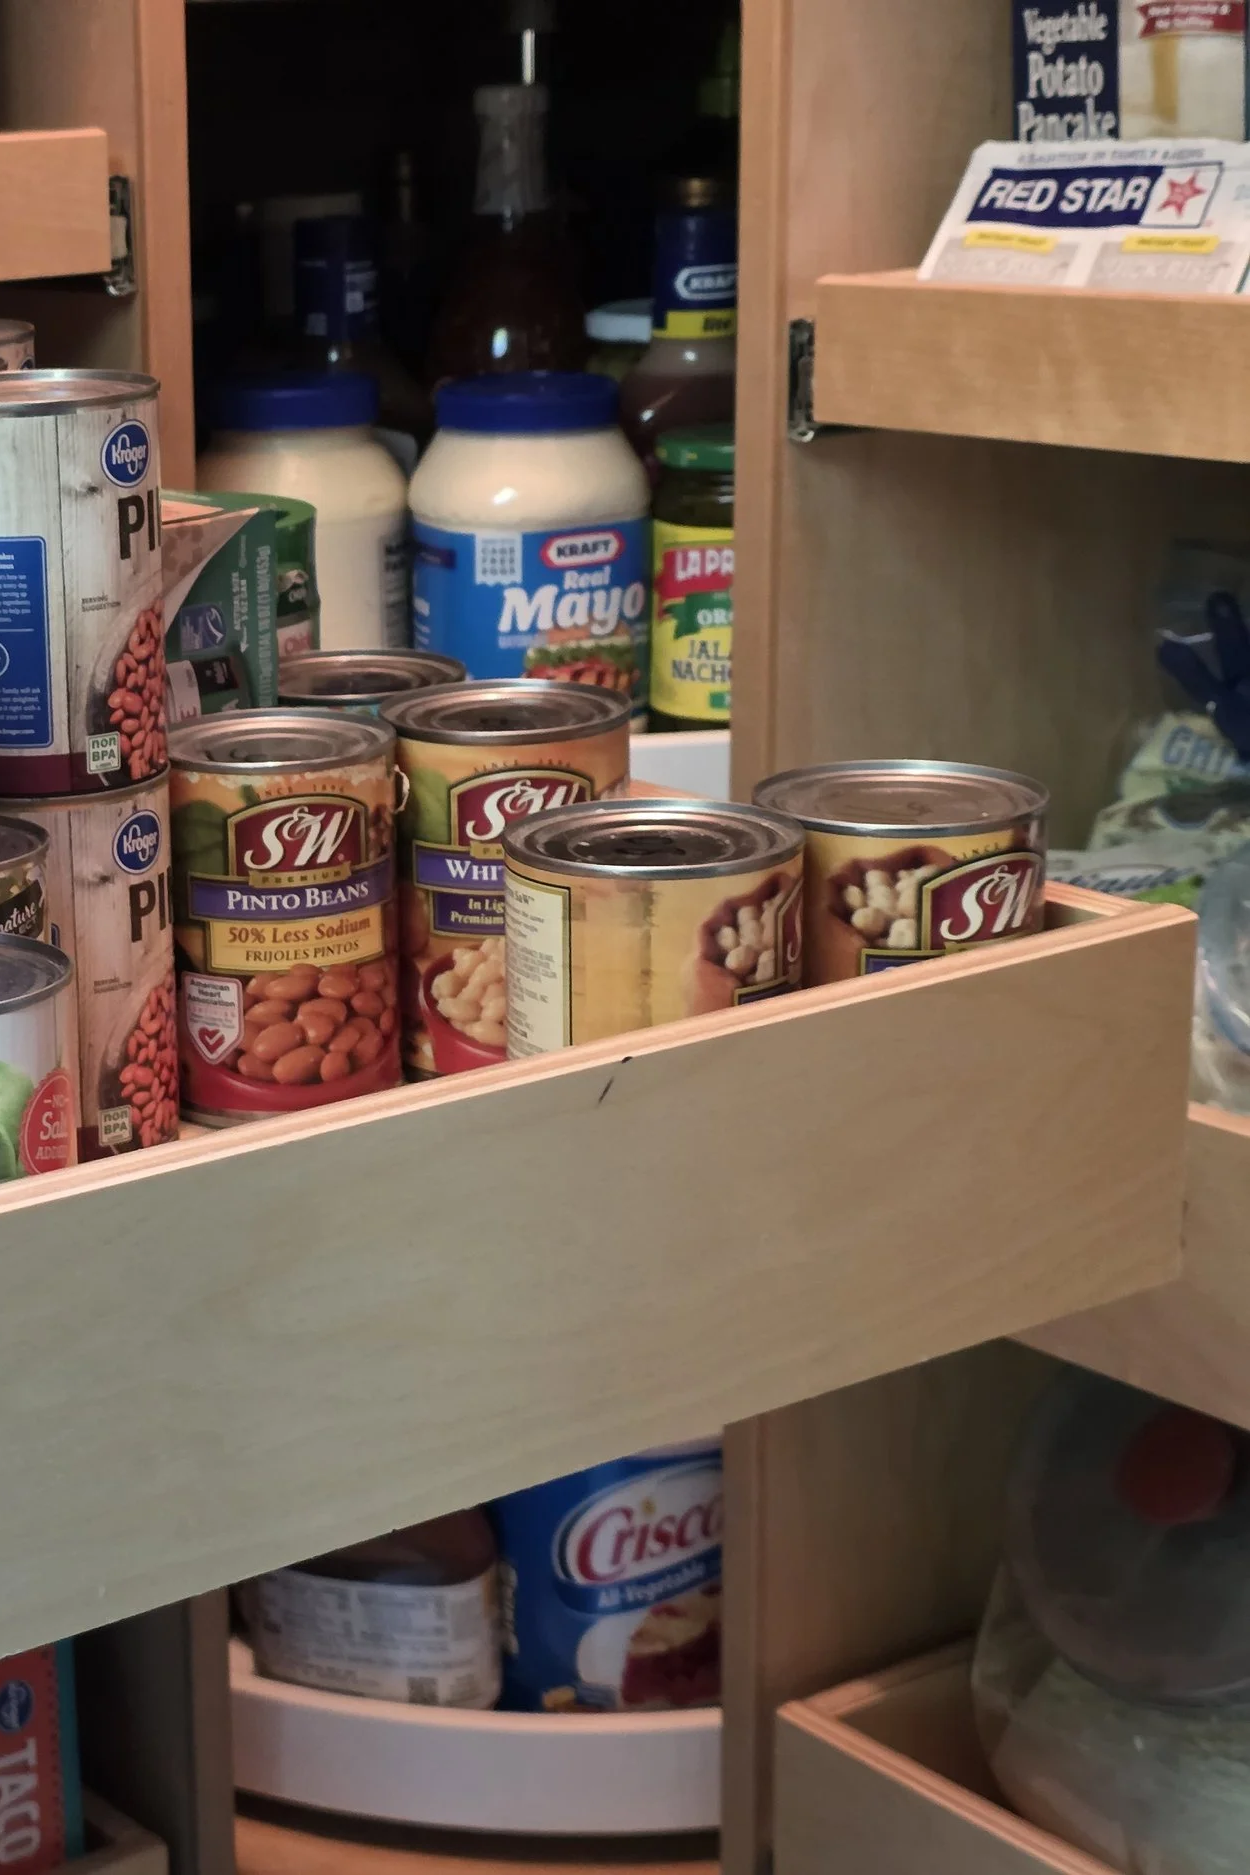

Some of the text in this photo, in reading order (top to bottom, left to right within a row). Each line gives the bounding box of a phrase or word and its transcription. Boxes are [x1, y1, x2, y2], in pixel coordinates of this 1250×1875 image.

[1022, 2, 1109, 56] Vegetable
[1026, 51, 1105, 99] Potato
[1017, 97, 1116, 143] Pancake
[978, 175, 1151, 214] RED STAR
[111, 433, 147, 476] Kroger
[117, 486, 162, 561] PI
[555, 538, 612, 560] KRAFT
[563, 565, 611, 591] Real
[673, 551, 701, 582] LA
[498, 582, 646, 636] Mayo
[688, 639, 731, 662] JAL
[91, 736, 117, 749] non
[92, 749, 116, 763] BPA
[466, 778, 580, 842] S&W
[122, 824, 158, 862] Kroger
[243, 805, 355, 871] S&W
[953, 841, 1000, 863] SINCE
[261, 869, 343, 885] PREMIUM
[445, 858, 505, 883] WHI
[226, 881, 370, 912] PINTO BEANS
[468, 897, 505, 916] In Lig
[939, 864, 1033, 941] S&W
[449, 909, 504, 926] Premium
[227, 916, 372, 945] 50% Less Sodium
[245, 940, 360, 965] FRIJOLES PINTOS
[189, 978, 231, 992] American
[197, 988, 222, 998] Heart
[187, 993, 236, 1008] Association
[103, 1110, 128, 1123] non
[103, 1121, 128, 1135] BPA
